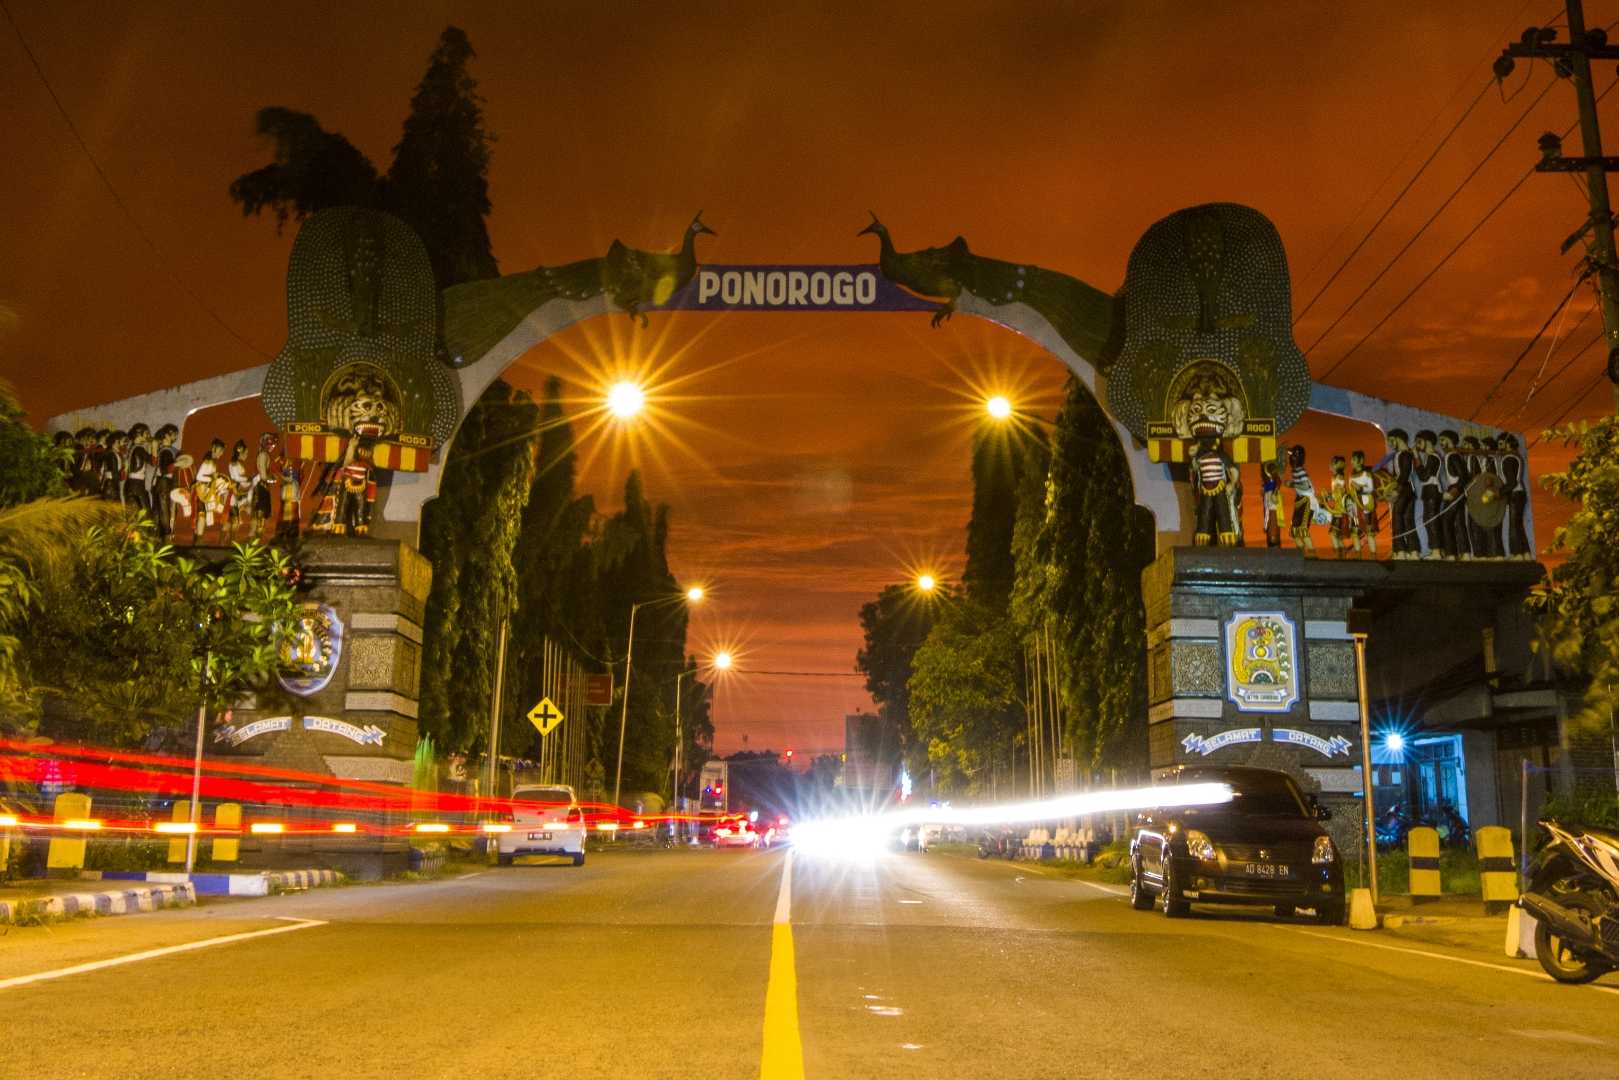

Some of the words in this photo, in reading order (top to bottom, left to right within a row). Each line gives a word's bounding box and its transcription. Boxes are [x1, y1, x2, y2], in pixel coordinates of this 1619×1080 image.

[699, 271, 876, 304] PONOROGO
[295, 424, 321, 432] PONO
[1151, 426, 1173, 434] PONO
[1246, 423, 1271, 433] ROGO
[1204, 729, 1258, 751] SELAMAT
[1287, 730, 1331, 751] DATANG
[1279, 864, 1289, 876] EN
